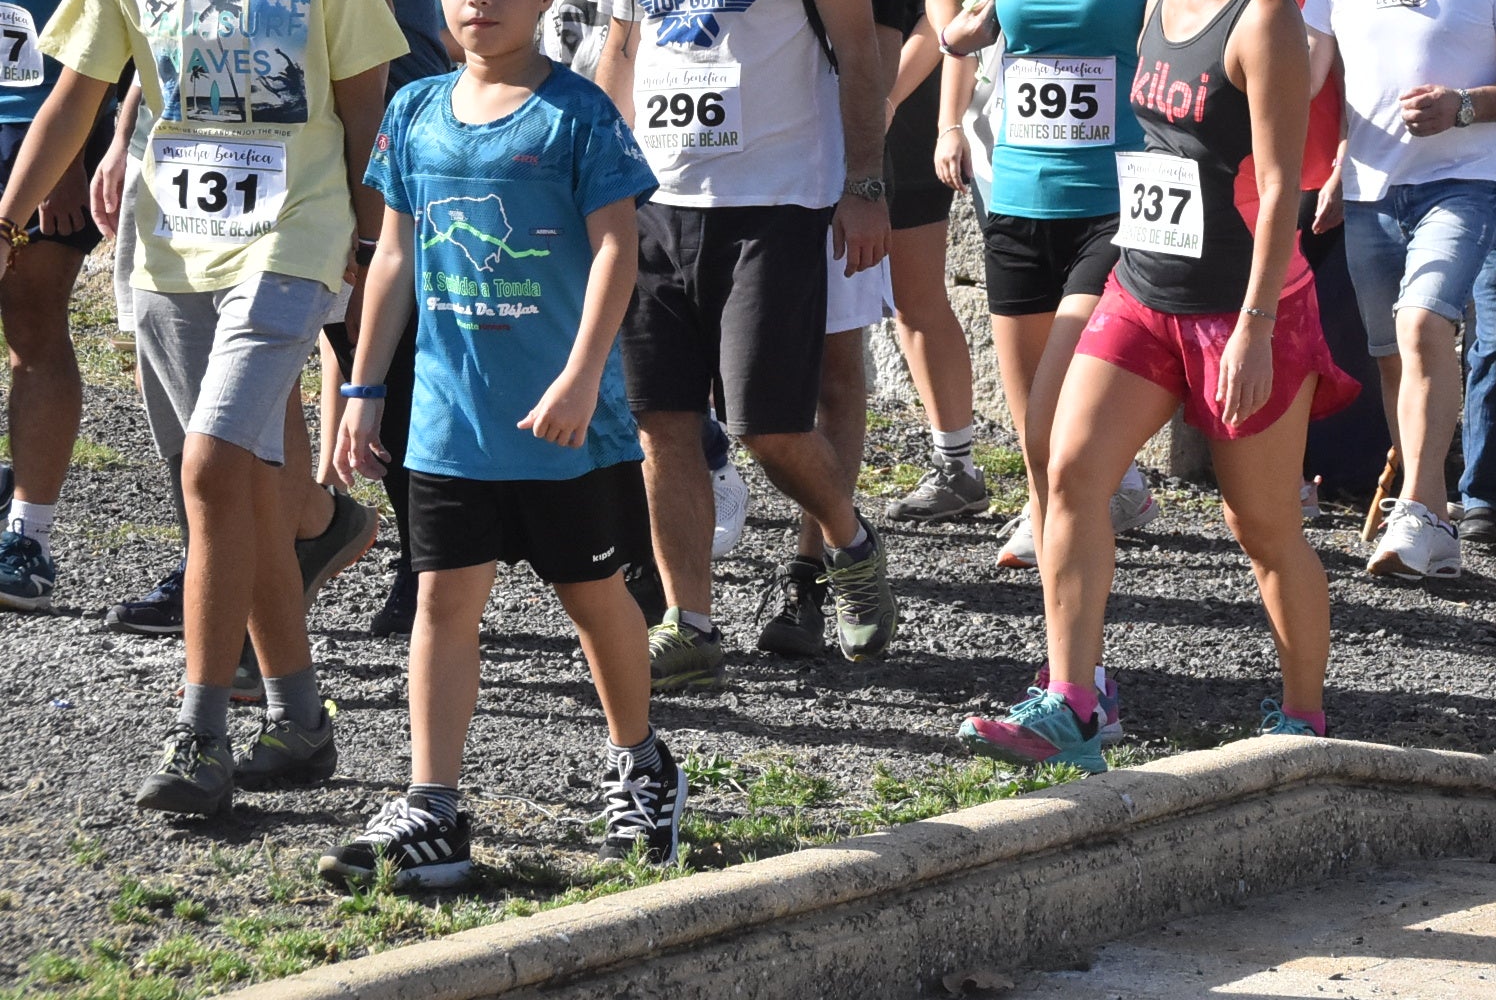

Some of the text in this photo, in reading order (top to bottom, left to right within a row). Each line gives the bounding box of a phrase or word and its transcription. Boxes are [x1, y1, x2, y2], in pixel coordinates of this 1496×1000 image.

[217, 10, 308, 38] SURF
[4, 65, 39, 81] BÉJAR
[683, 70, 727, 86] benéfica
[1053, 60, 1104, 78] benéfica
[1017, 82, 1099, 120] 395
[1130, 55, 1210, 124] kilpi
[647, 92, 726, 128] 296
[681, 133, 696, 148] DE
[699, 129, 739, 148] BÉJAR
[1009, 122, 1110, 141] FUENTES DE BÉJAR
[163, 143, 273, 166] marcha benéfica
[172, 168, 258, 214] 131
[1130, 182, 1191, 226] 337
[161, 213, 208, 235] FUENTES
[211, 219, 227, 236] DE
[1148, 228, 1160, 245] DE
[1163, 228, 1199, 250] BÉJAR
[422, 271, 542, 298] X Subida a Tonda
[475, 302, 496, 316] De
